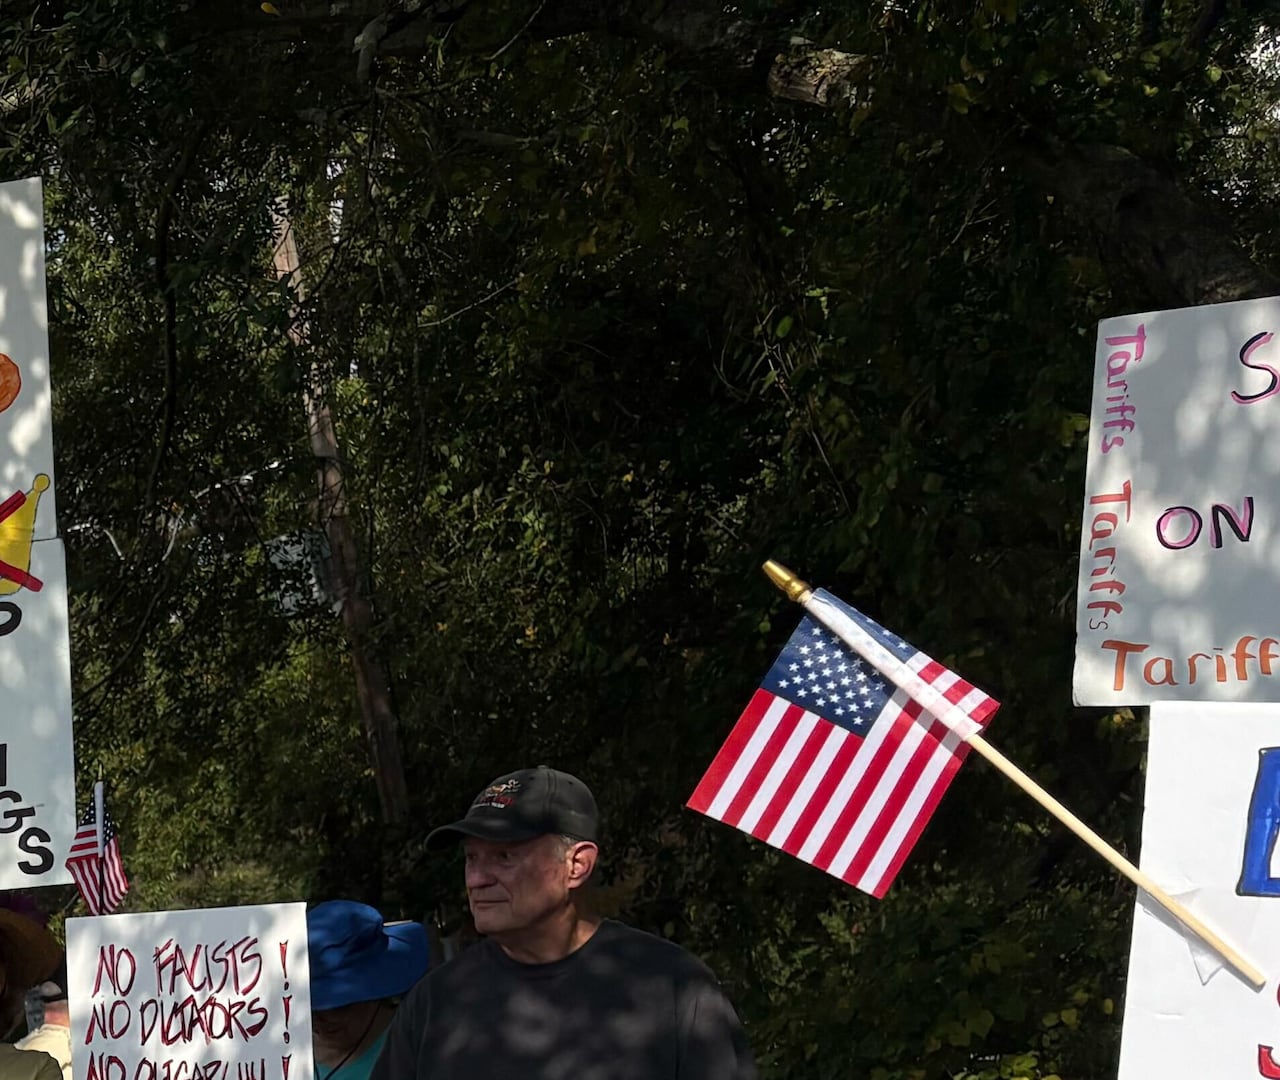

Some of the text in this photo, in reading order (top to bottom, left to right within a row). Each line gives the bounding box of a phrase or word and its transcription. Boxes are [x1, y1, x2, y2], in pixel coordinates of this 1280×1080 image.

[1101, 324, 1147, 455] Tariffs
[1156, 496, 1254, 550] ON
[1087, 479, 1132, 632] Tariffs
[92, 943, 136, 998] NO
[153, 936, 264, 996] FACISTS
[84, 1000, 131, 1046] NO
